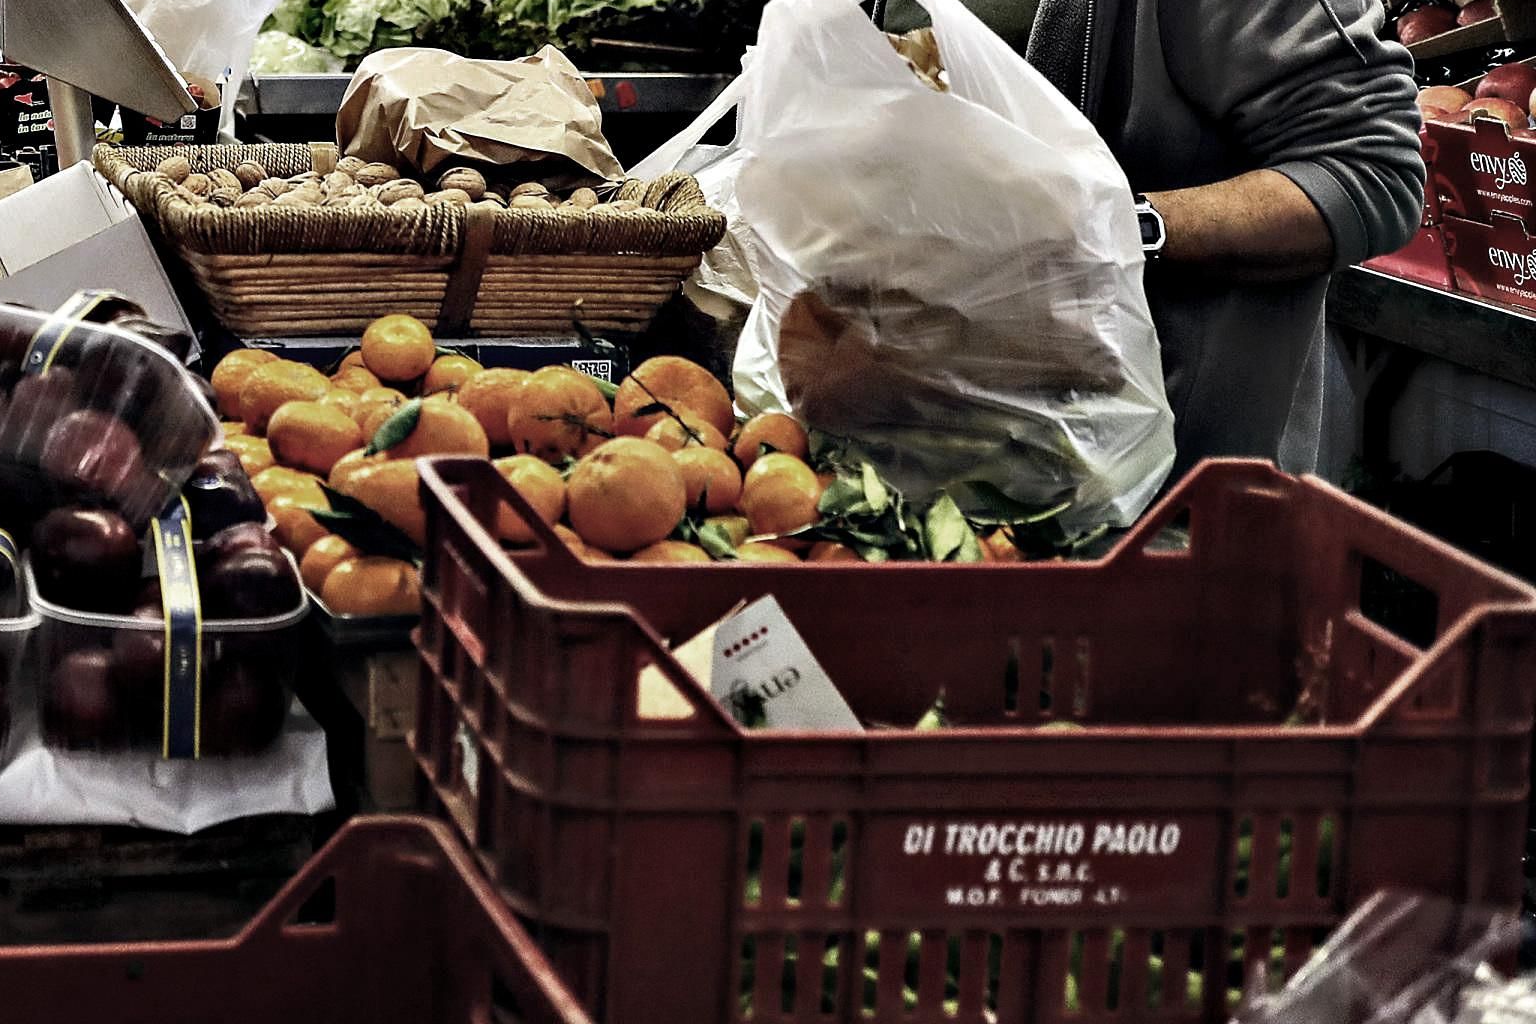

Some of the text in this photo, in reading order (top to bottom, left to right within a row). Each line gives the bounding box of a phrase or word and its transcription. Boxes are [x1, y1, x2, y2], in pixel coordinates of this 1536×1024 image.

[1470, 152, 1512, 189] envy
[1489, 247, 1531, 285] envy
[903, 822, 1181, 856] DI TROCCHIO PAOLO
